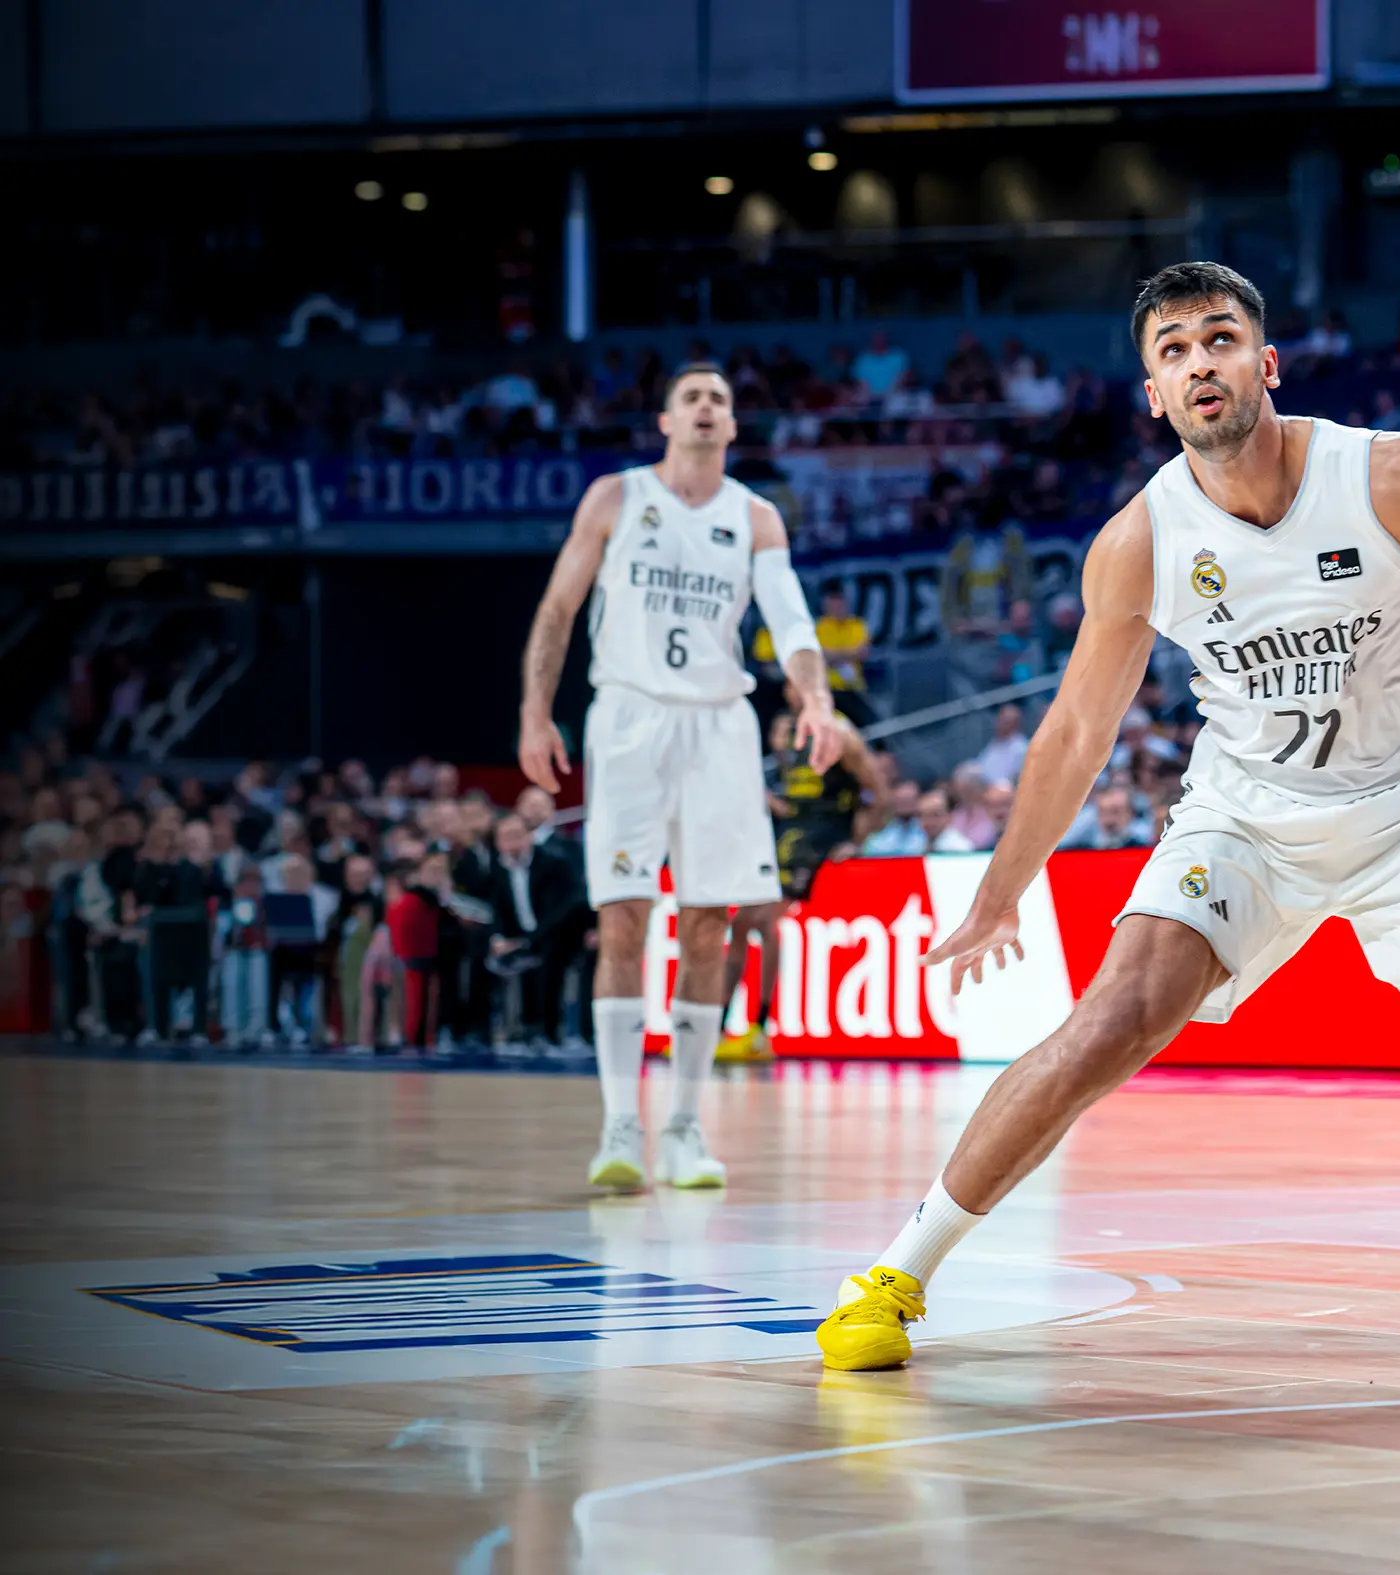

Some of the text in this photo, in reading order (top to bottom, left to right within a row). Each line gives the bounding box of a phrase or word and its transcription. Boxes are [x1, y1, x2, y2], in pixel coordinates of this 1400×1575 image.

[630, 560, 735, 602] Emirates
[1322, 566, 1361, 579] endesa
[665, 627, 689, 669] 6
[1202, 609, 1383, 674] Emirates
[1248, 665, 1285, 699] FLY
